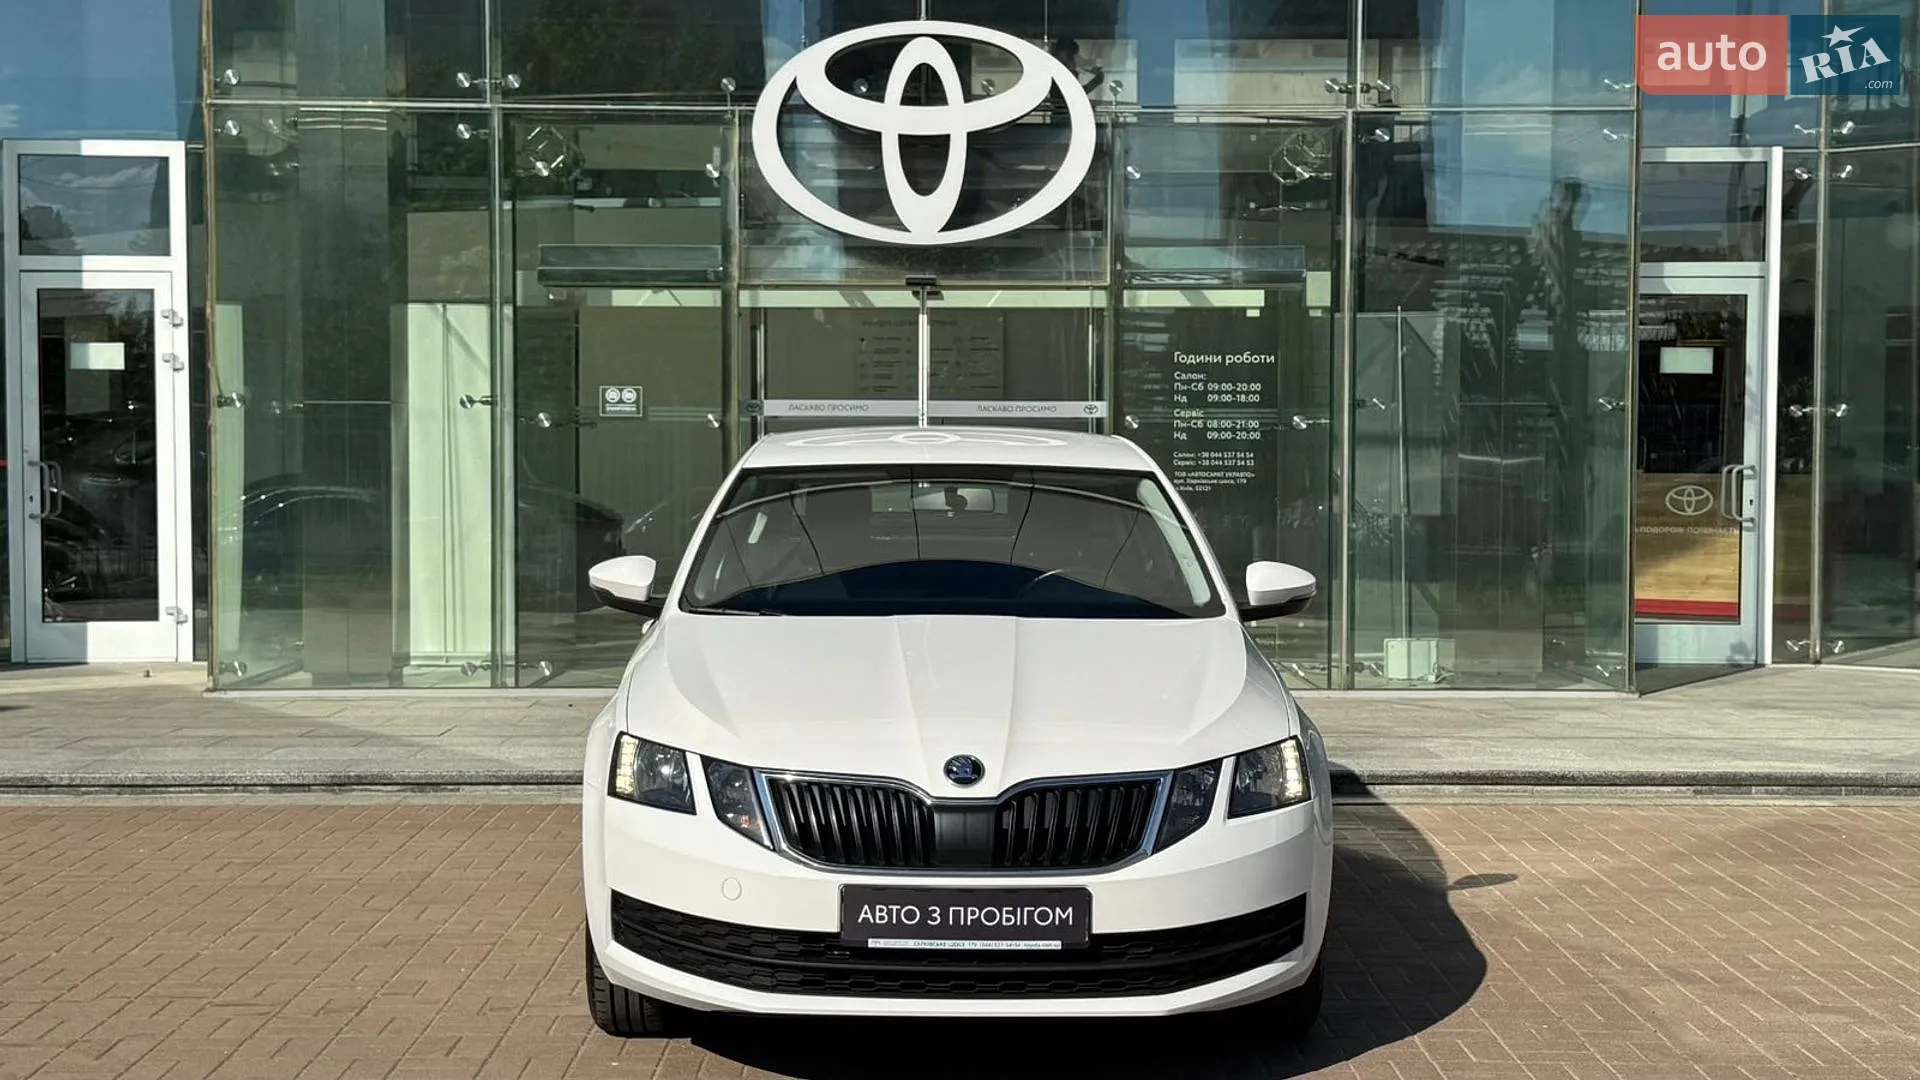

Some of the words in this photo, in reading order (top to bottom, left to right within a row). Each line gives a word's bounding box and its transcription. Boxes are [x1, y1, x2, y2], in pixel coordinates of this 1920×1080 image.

[1173, 351, 1222, 365] Години
[1225, 351, 1276, 366] роботи
[1173, 371, 1207, 380] Салон:
[1173, 382, 1205, 391] Пн-Сб
[1207, 382, 1262, 391] 09:00-20:00
[1173, 394, 1188, 403] Нд
[1207, 394, 1260, 402] 09:00-18:00
[1173, 420, 1205, 429] Пн-Сб
[1206, 420, 1260, 429] 08:00-21:00
[1173, 431, 1188, 440] Нд
[1206, 431, 1261, 440] 09:00-20:00
[858, 904, 920, 925] АВТО
[927, 905, 941, 925] З
[949, 906, 1073, 926] ПРОБІГОМ
